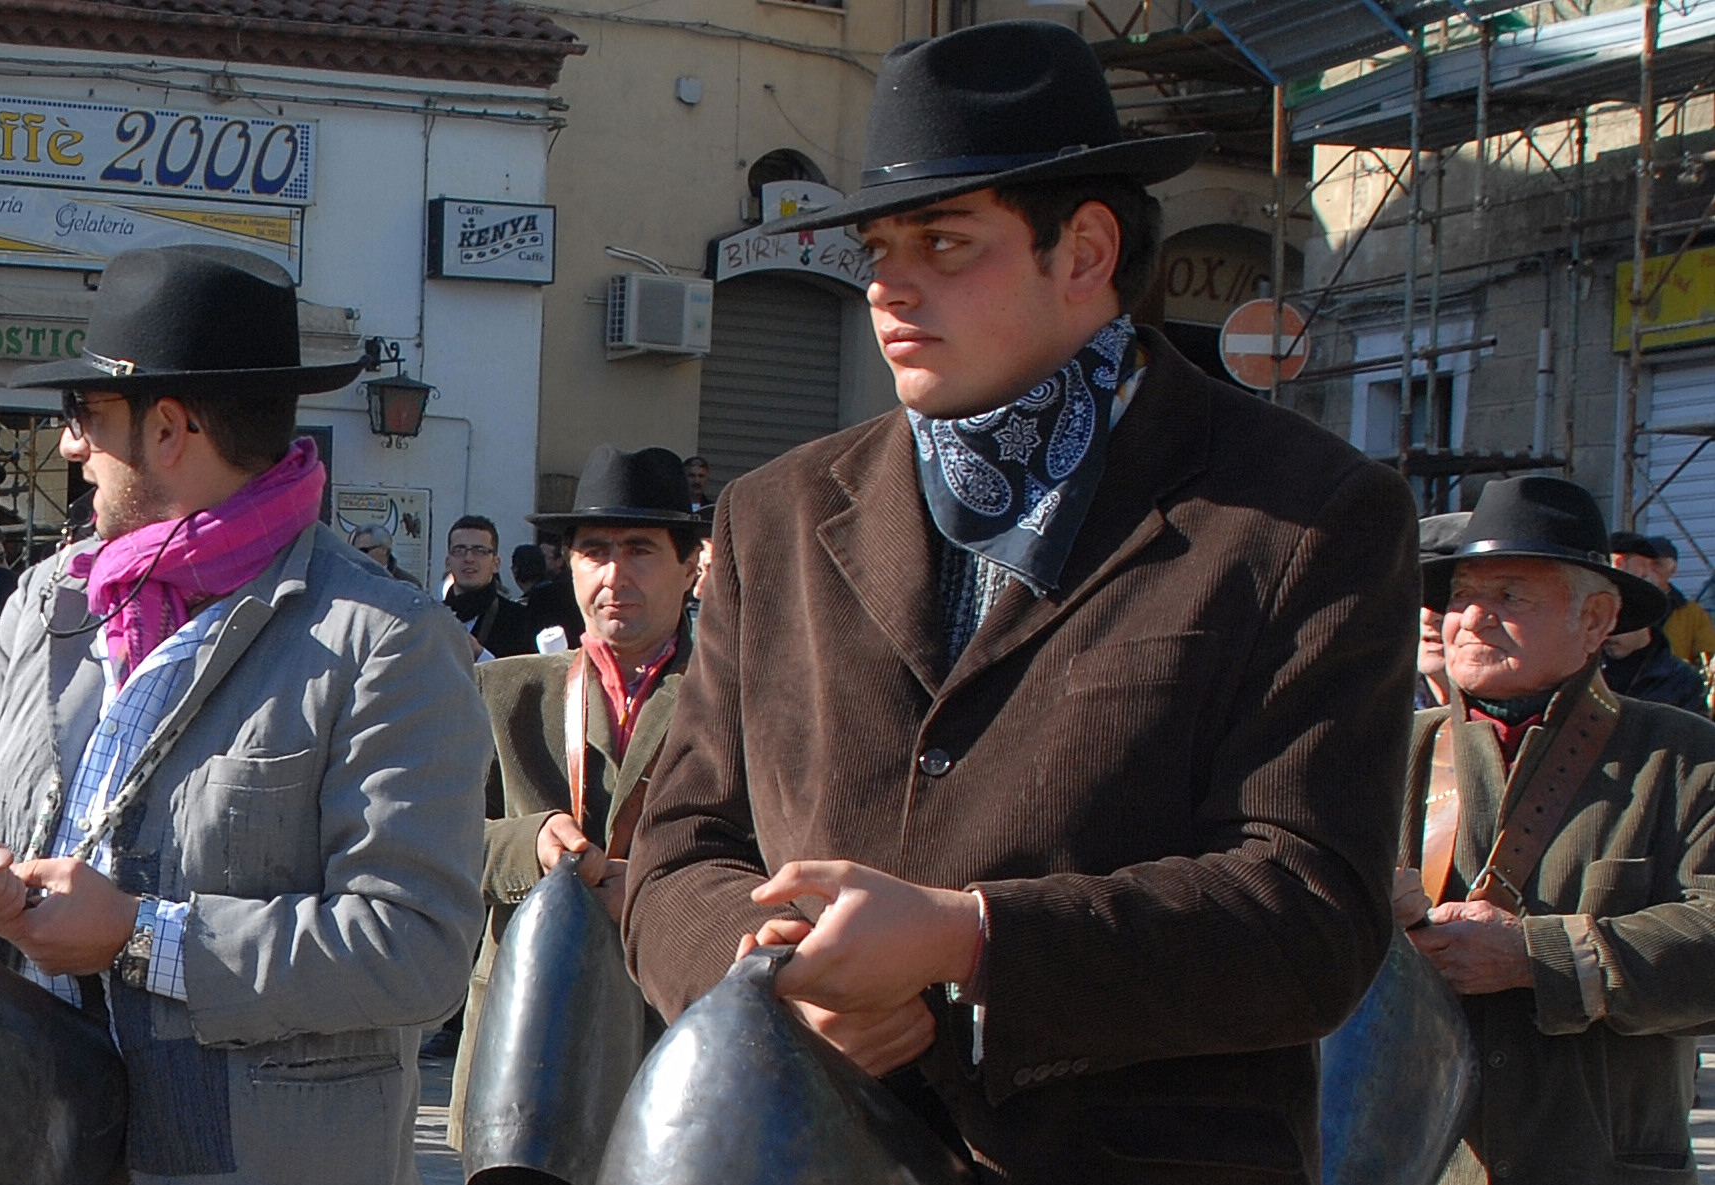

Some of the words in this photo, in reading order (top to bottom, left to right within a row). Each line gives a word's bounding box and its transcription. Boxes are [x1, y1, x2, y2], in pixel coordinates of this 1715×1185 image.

[99, 110, 299, 195] 2000
[55, 202, 134, 236] Gelateria
[457, 205, 484, 215] Caffè
[457, 214, 539, 248] KENYA
[518, 251, 545, 262] Caffè
